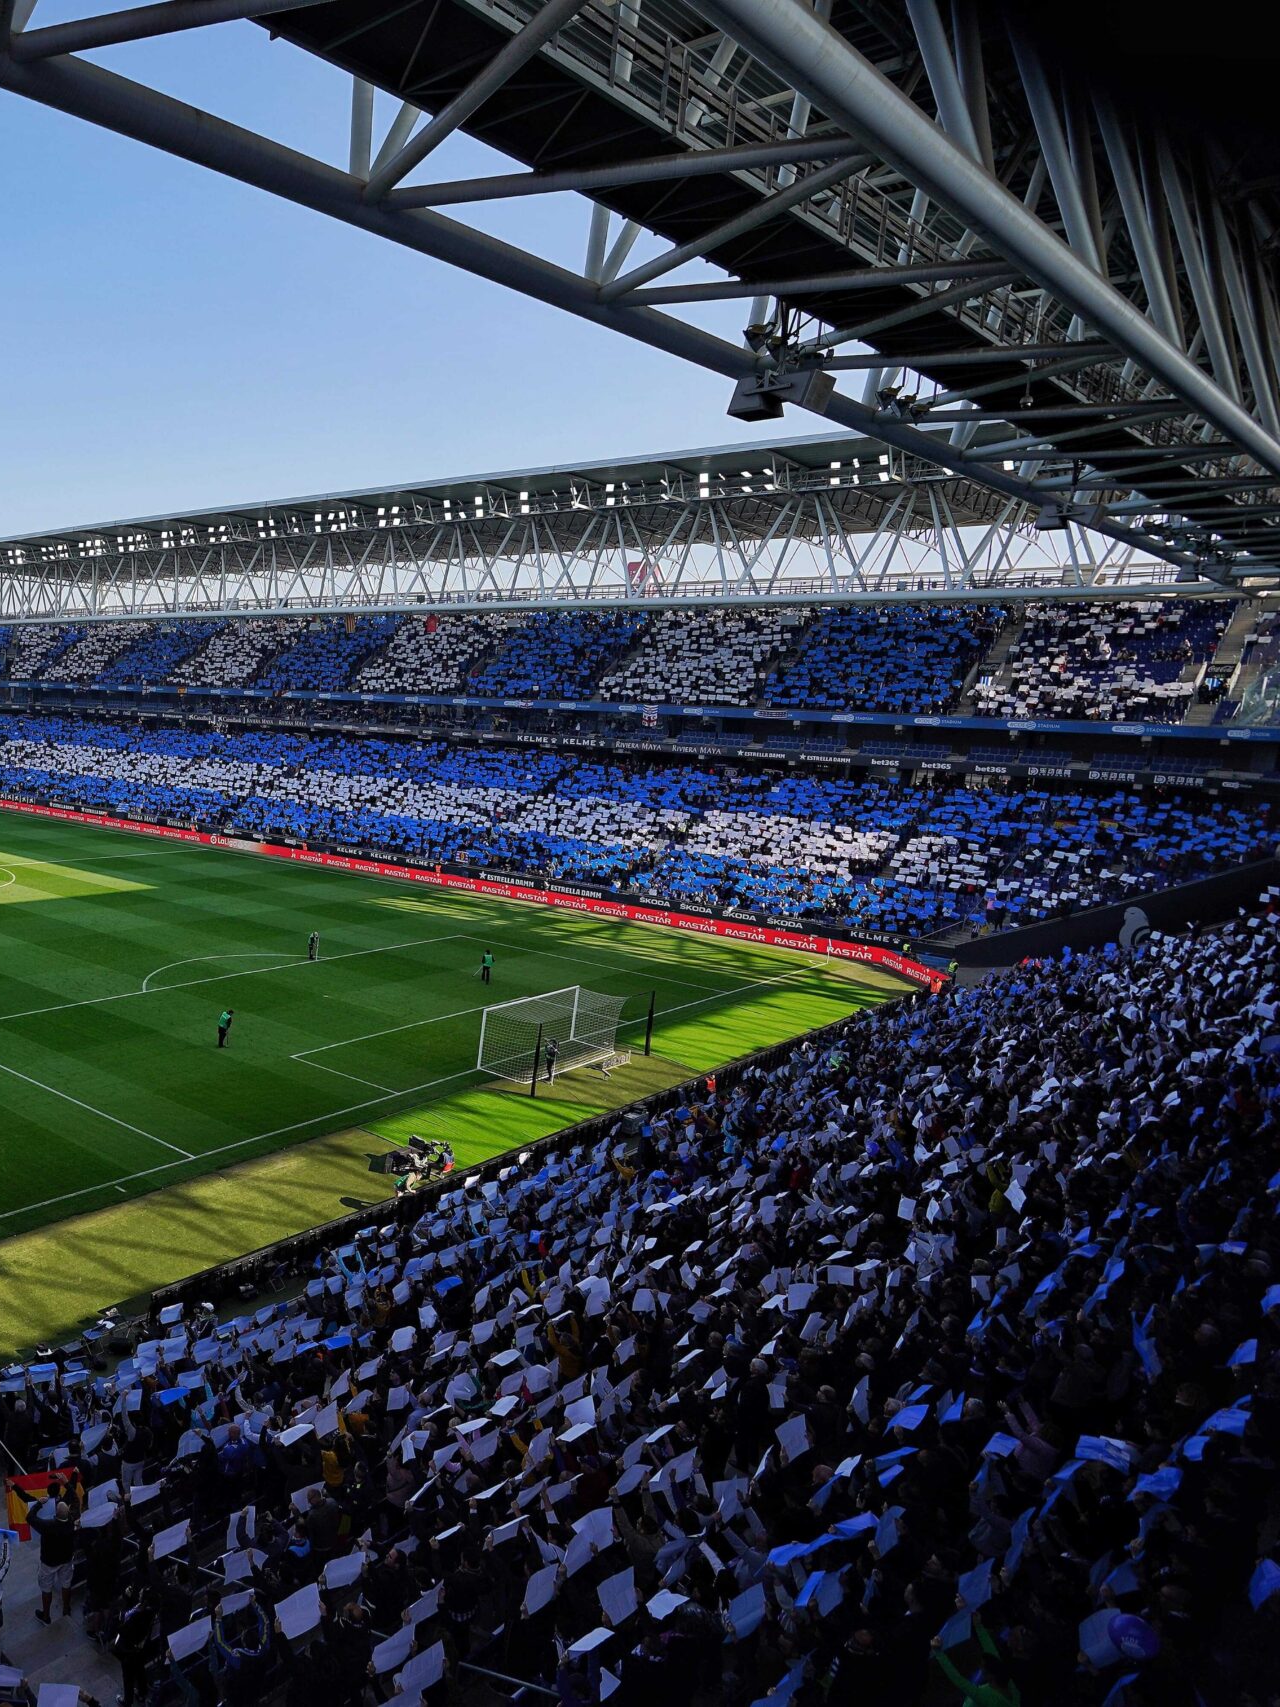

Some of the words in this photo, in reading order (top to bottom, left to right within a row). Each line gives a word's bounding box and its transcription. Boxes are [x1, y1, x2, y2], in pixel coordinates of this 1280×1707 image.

[616, 741, 639, 749] RIVIERA
[672, 744, 696, 753] RIVIERA
[699, 747, 721, 755] MAYA
[975, 765, 1006, 773] bet365
[300, 854, 322, 863] RASTAR
[327, 858, 351, 868] RASTAR
[355, 863, 380, 873] RASTAR
[384, 869, 410, 878] RASTAR
[415, 874, 442, 885] RASTAR
[447, 880, 476, 890] RASTAR
[487, 873, 514, 885] ESTRELLA
[514, 878, 534, 888] DAMM
[482, 885, 511, 896] RASTAR
[551, 884, 580, 895] ESTRELLA
[581, 889, 601, 899] DAMM
[517, 892, 548, 903] RASTAR
[639, 897, 670, 907] ŠKODA
[554, 898, 587, 910] RASTAR
[680, 903, 712, 914] ŠKODA
[594, 905, 628, 917] RASTAR
[722, 910, 757, 921] ŠKODA
[635, 913, 671, 924] RASTAR
[767, 917, 803, 929] ŠKODA
[679, 920, 717, 933] RASTAR
[725, 929, 765, 941] RASTAR
[851, 931, 889, 942] KELME
[774, 938, 817, 950] RASTAR
[827, 947, 872, 960] RASTAR
[882, 956, 903, 970] RASTAR
[906, 967, 931, 982] RASTAR
